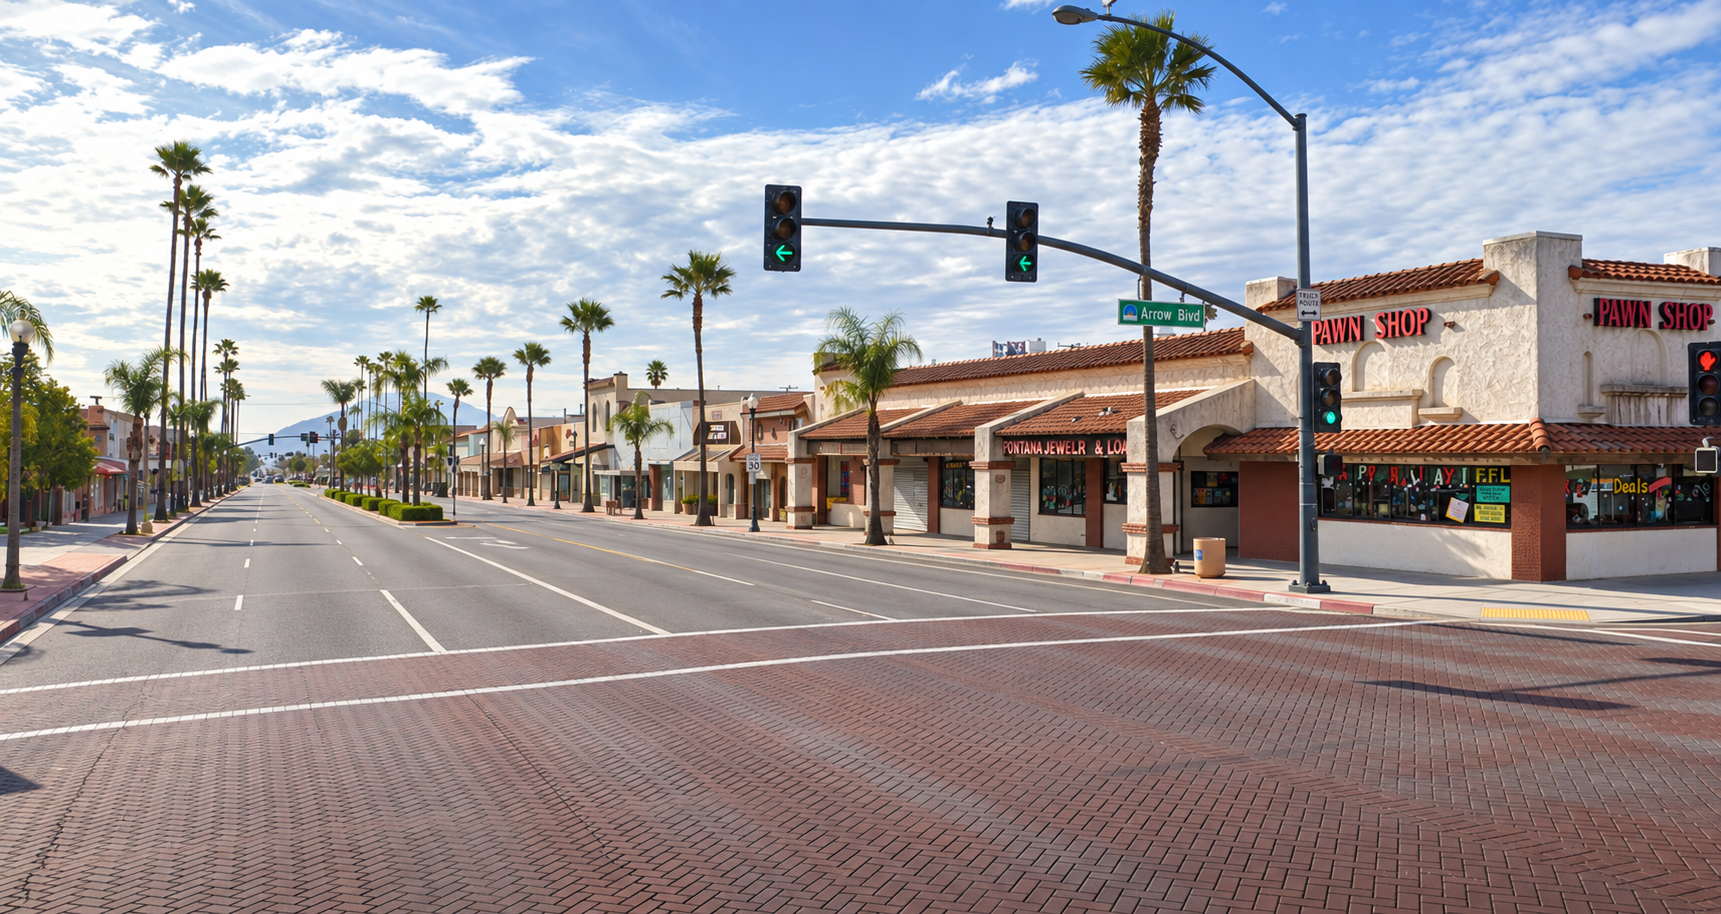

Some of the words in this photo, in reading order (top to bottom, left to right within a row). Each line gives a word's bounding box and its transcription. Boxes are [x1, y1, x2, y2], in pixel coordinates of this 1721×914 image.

[1140, 306, 1172, 321] Arrow
[1594, 298, 1652, 328] PAWN
[1658, 302, 1714, 331] SHOP
[1312, 315, 1365, 345] PAWN
[1374, 307, 1431, 339] SHOP
[1094, 439, 1104, 455] &
[1613, 477, 1649, 494] Deals
